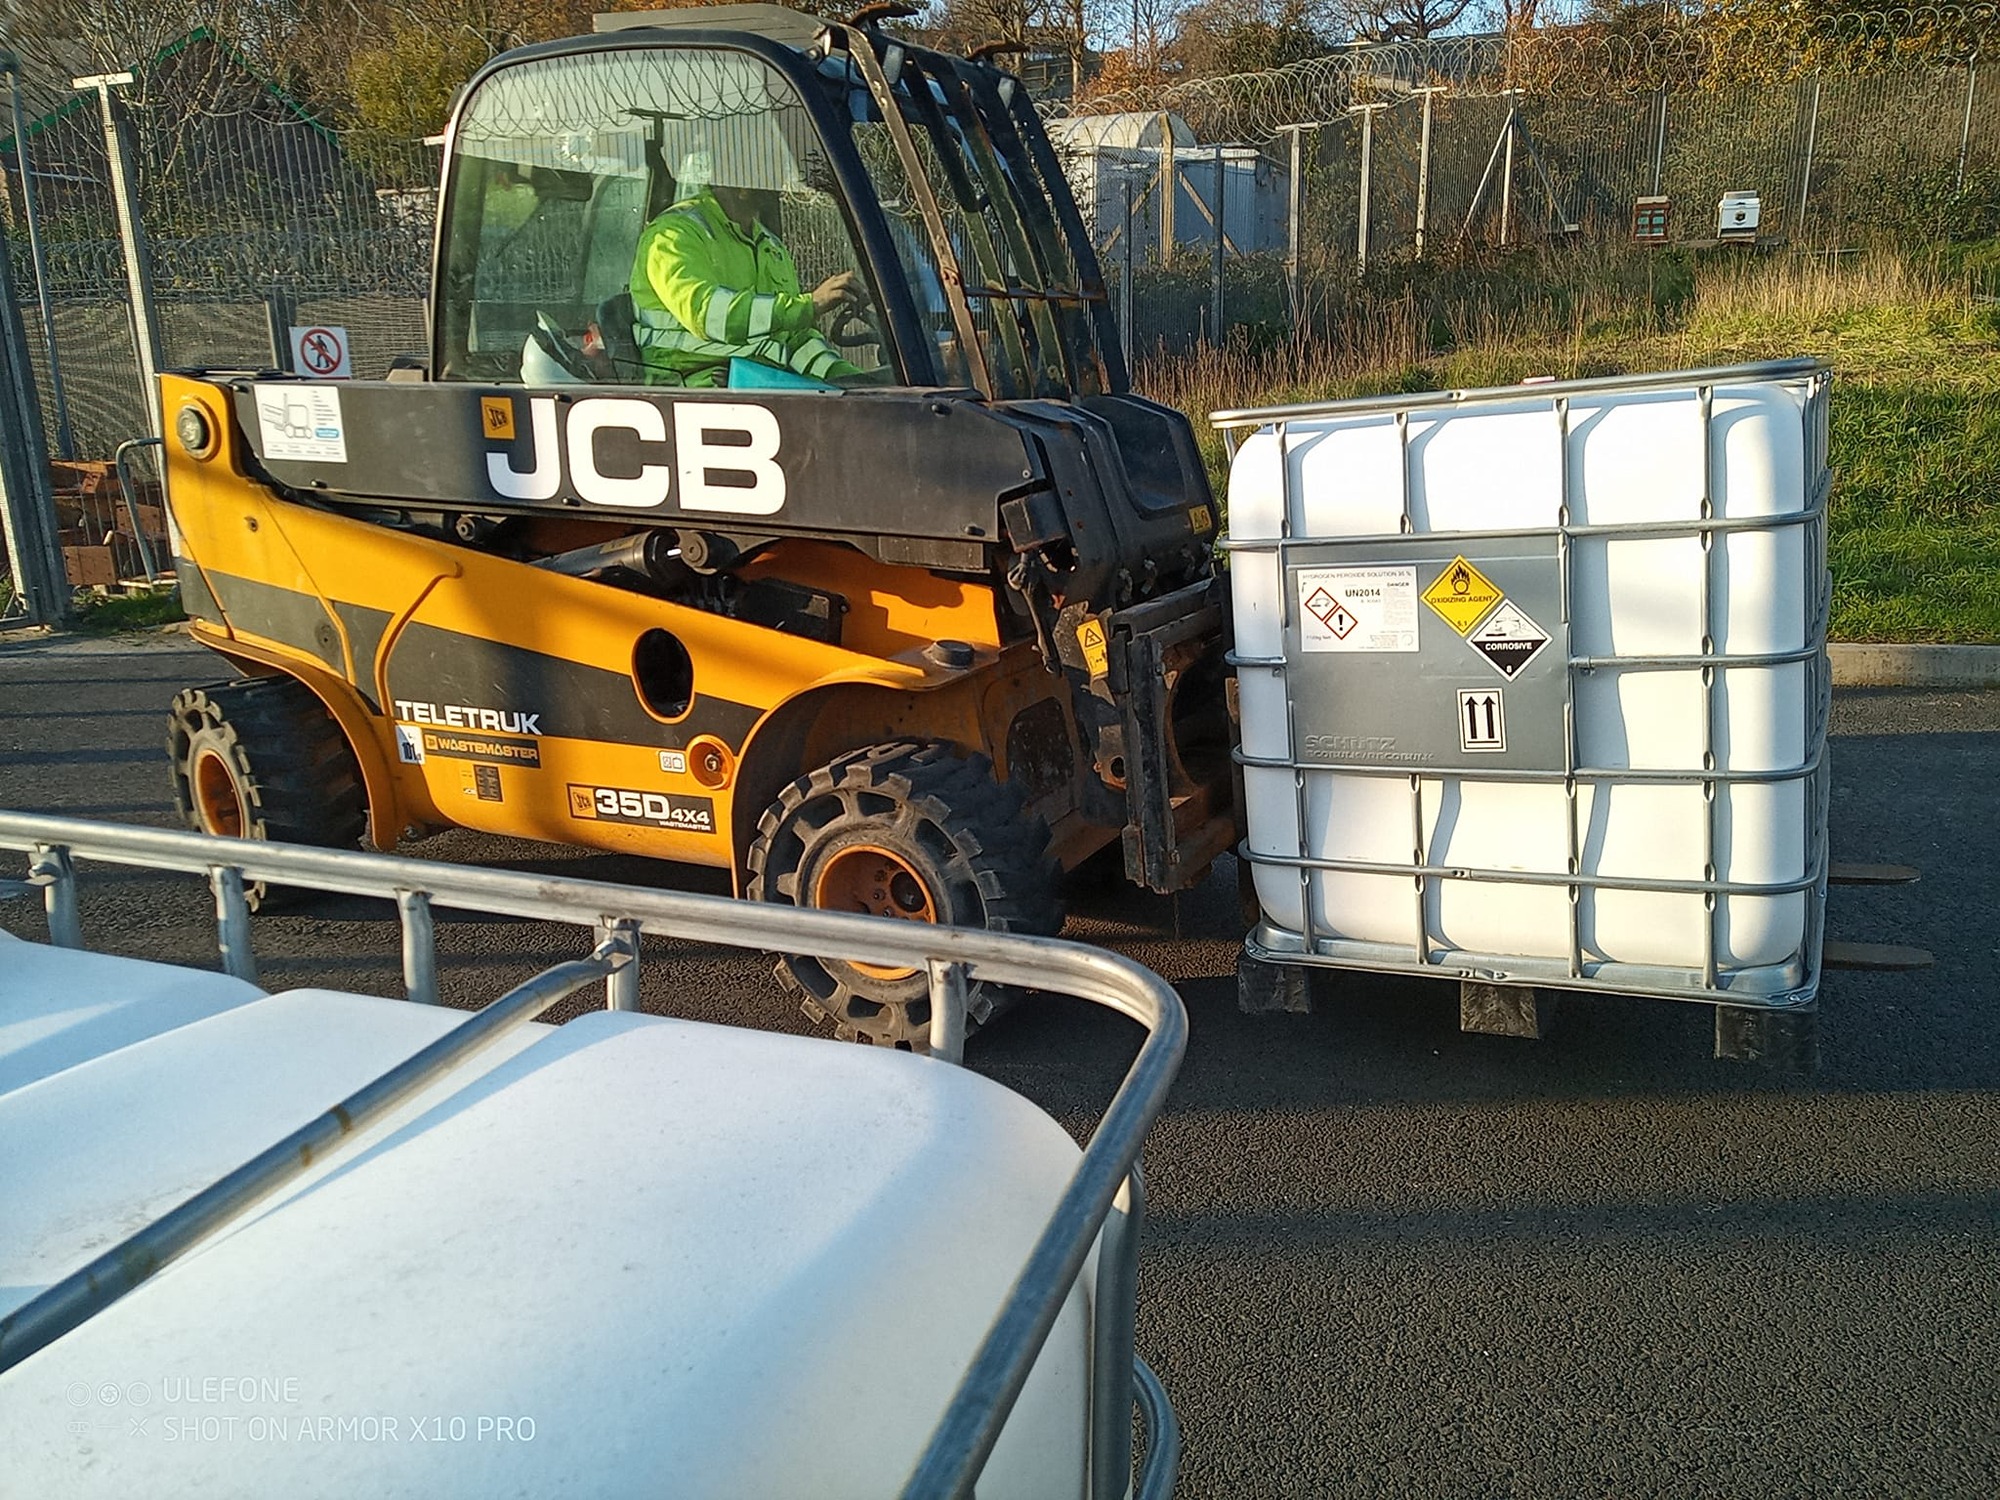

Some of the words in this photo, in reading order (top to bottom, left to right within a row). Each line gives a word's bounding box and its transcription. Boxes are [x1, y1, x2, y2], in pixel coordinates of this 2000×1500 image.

[486, 397, 787, 516] JCB
[1303, 572, 1335, 580] HYDROGEN
[1336, 571, 1366, 579] PEROXIDE
[1367, 570, 1397, 578] SOLUTION
[1345, 588, 1381, 597] UN2014
[1485, 642, 1533, 651] CORROSIVE
[1506, 665, 1512, 673] 8
[395, 700, 543, 736] TELETRUK
[438, 737, 539, 761] WASTEMASTER
[595, 788, 671, 820] 35D
[670, 808, 710, 824] 4X4
[659, 820, 712, 831] WASTEMASTER
